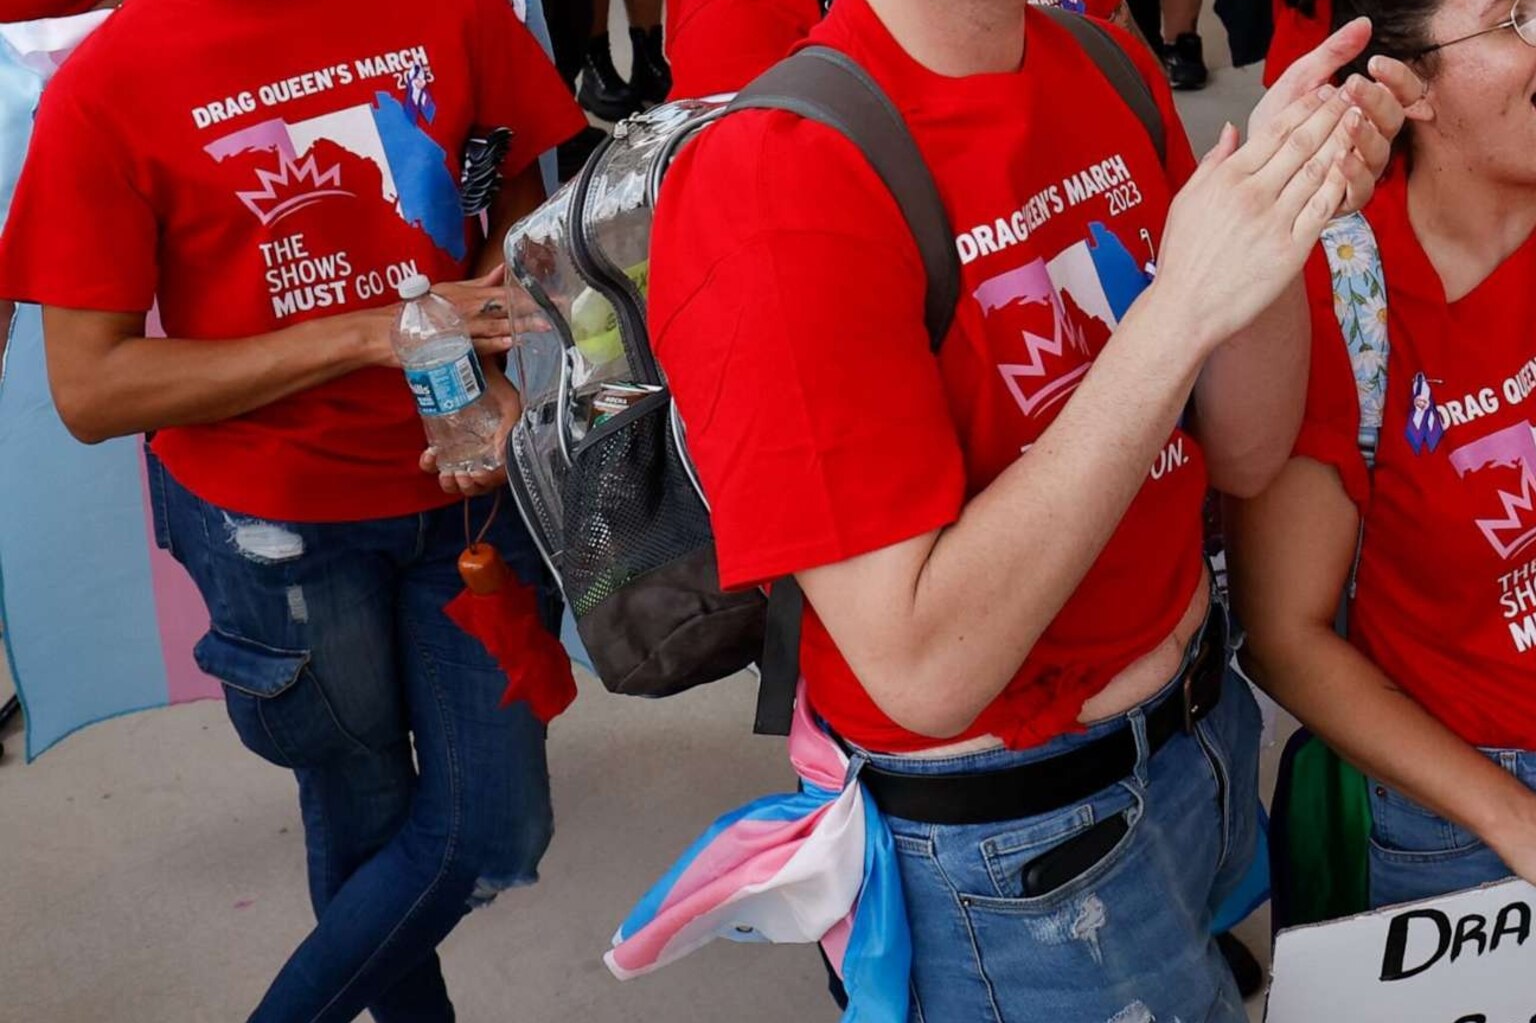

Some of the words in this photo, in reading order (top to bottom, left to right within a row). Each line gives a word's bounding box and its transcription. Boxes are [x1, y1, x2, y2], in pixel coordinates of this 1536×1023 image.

[191, 91, 257, 130] DRAG
[258, 64, 353, 106] QUEEN'S
[355, 45, 429, 80] MARCH
[956, 211, 1027, 265] DRAG
[1062, 154, 1131, 207] MARCH
[1104, 181, 1142, 216] 2023
[259, 233, 309, 267] THE
[265, 251, 352, 294] SHOWS
[271, 280, 347, 319] MUST
[355, 270, 384, 300] GO
[1437, 387, 1499, 431] DRAG
